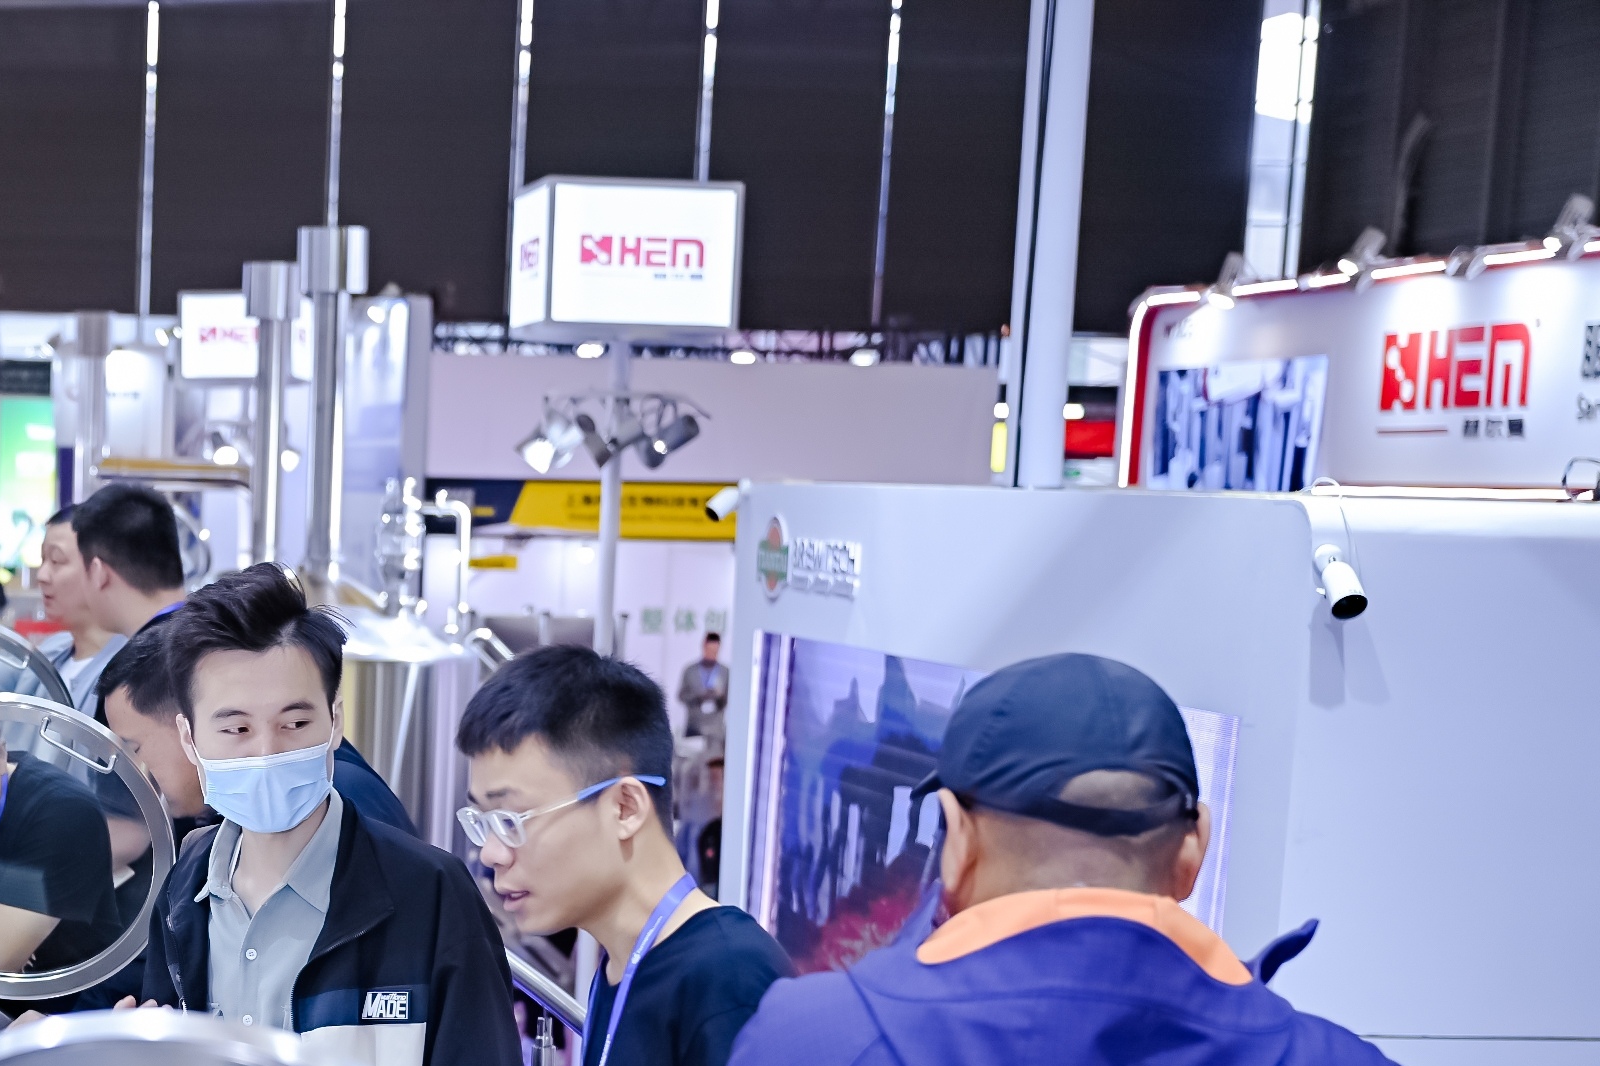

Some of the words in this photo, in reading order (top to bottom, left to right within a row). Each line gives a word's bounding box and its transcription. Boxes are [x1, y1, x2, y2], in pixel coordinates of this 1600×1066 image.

[619, 235, 705, 269] HEM
[1425, 323, 1531, 410] HEM
[362, 992, 407, 1018] MADE
